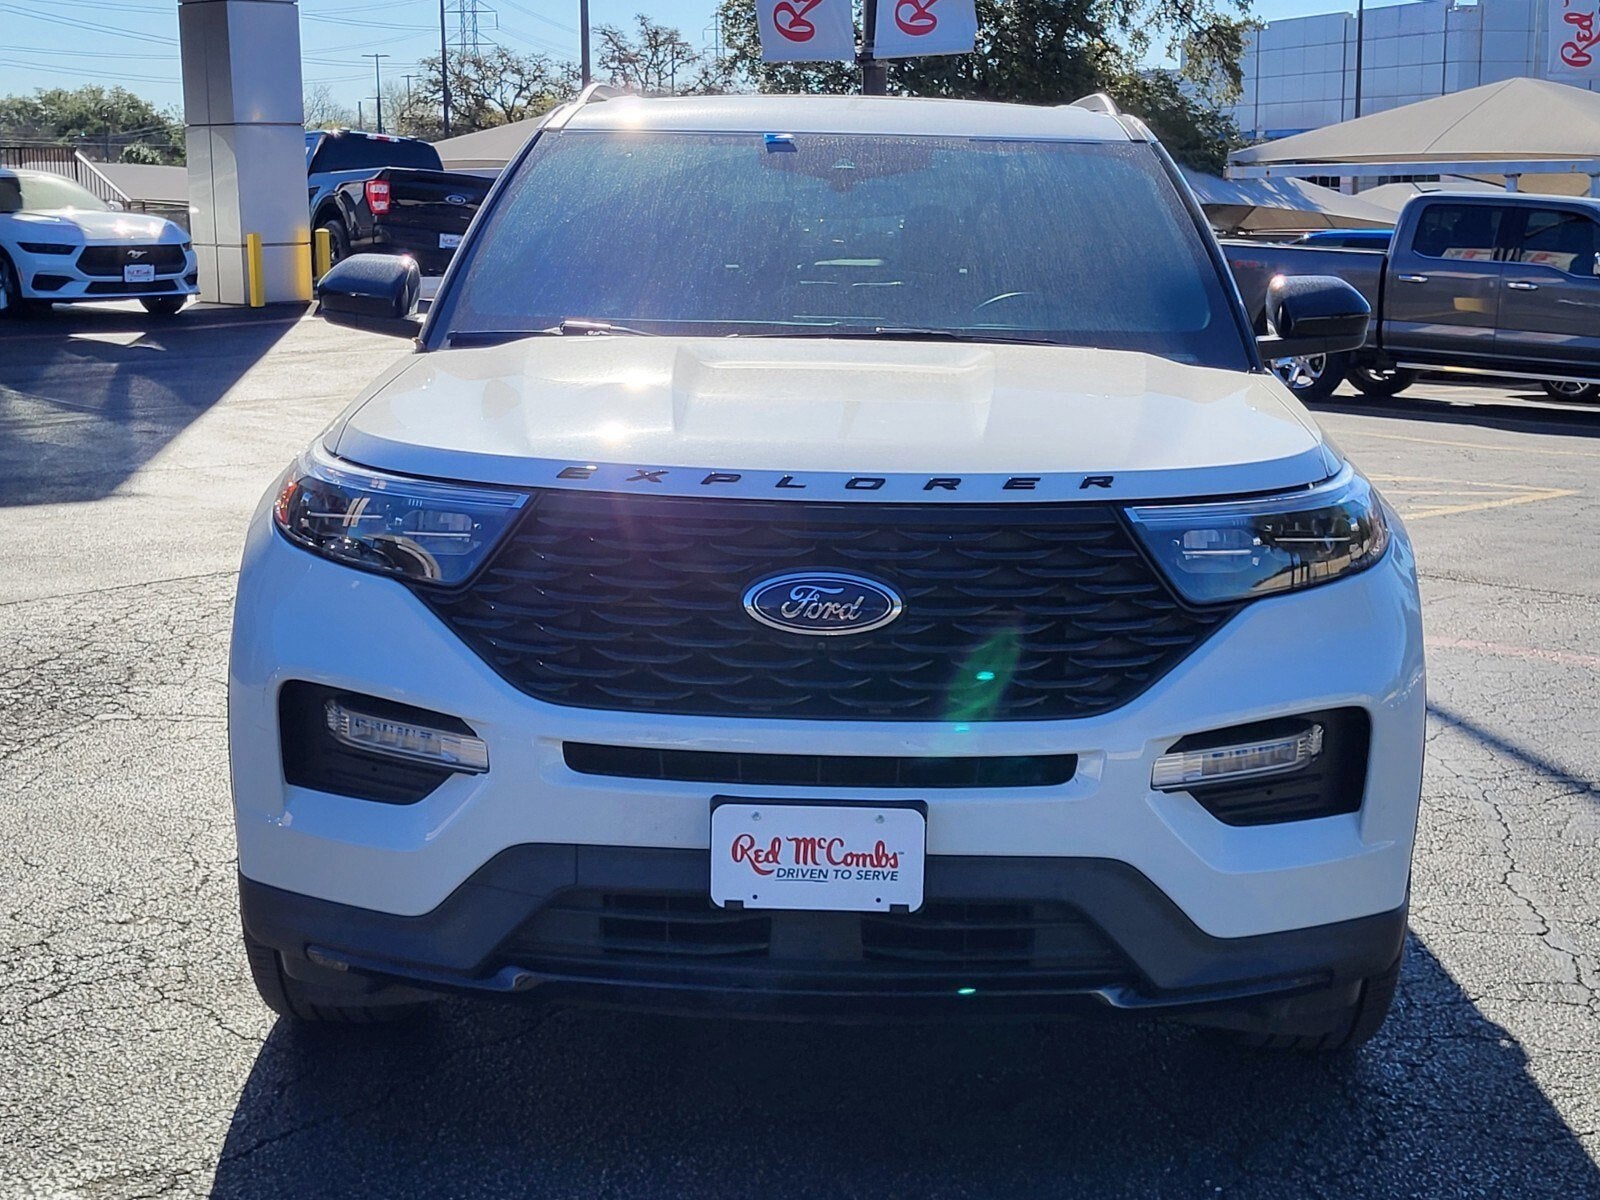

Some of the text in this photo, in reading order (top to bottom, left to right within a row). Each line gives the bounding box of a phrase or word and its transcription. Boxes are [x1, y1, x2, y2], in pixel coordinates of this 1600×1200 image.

[1560, 11, 1600, 68] Red
[556, 465, 1114, 491] EXPLORER
[780, 585, 865, 620] Ford
[731, 834, 782, 876] Red
[776, 868, 899, 881] DRIVEN TO SERVE
